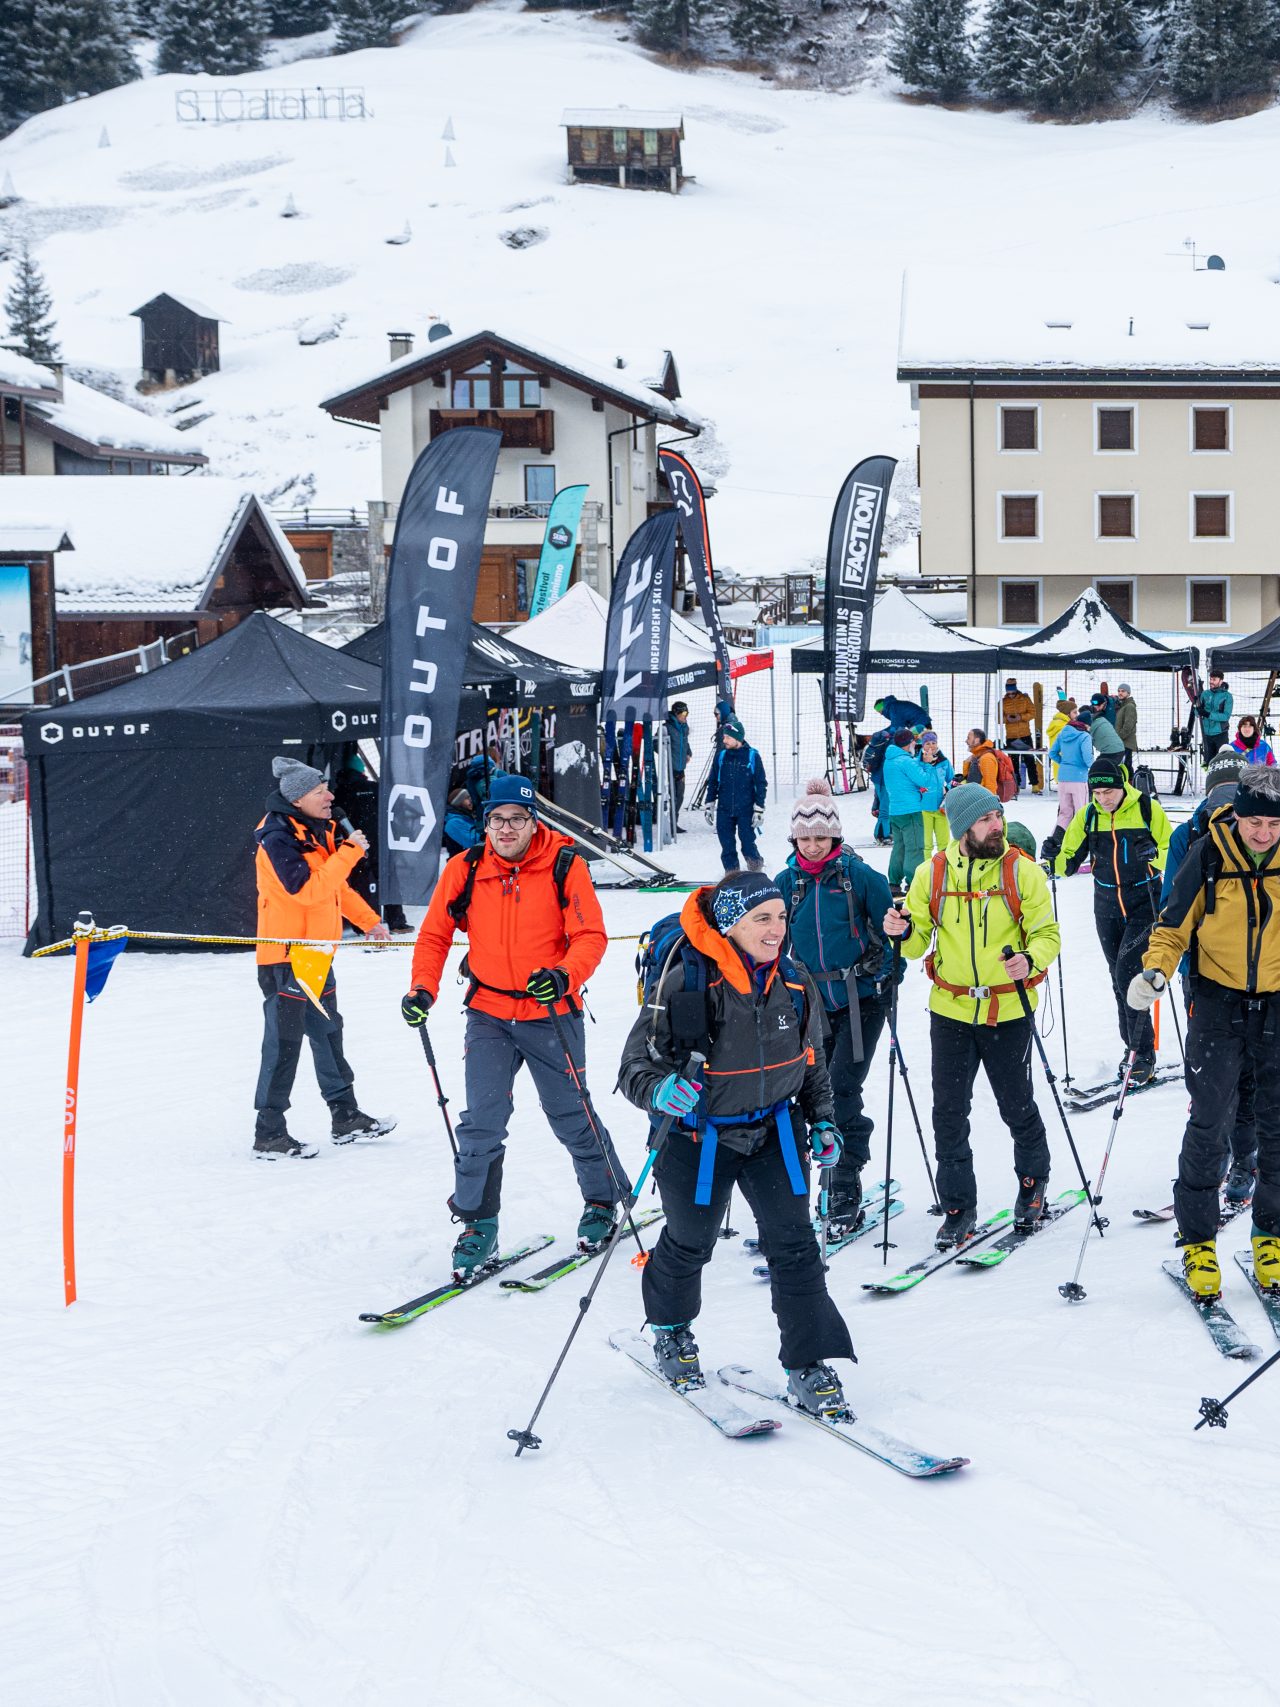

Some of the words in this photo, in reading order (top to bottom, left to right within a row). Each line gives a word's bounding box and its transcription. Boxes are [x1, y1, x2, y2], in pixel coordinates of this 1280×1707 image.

[844, 489, 877, 583] FACTION
[403, 605, 447, 748] OUT
[427, 486, 465, 571] OF
[837, 608, 849, 623] IS
[651, 607, 661, 674] INDEPENDENT
[835, 626, 848, 685] MOUNTAIN
[848, 611, 864, 693] PLAYGROUND
[352, 713, 378, 726] OUT
[835, 687, 847, 715] THE
[848, 695, 858, 715] MY
[72, 725, 115, 738] OUT
[123, 723, 150, 736] OF
